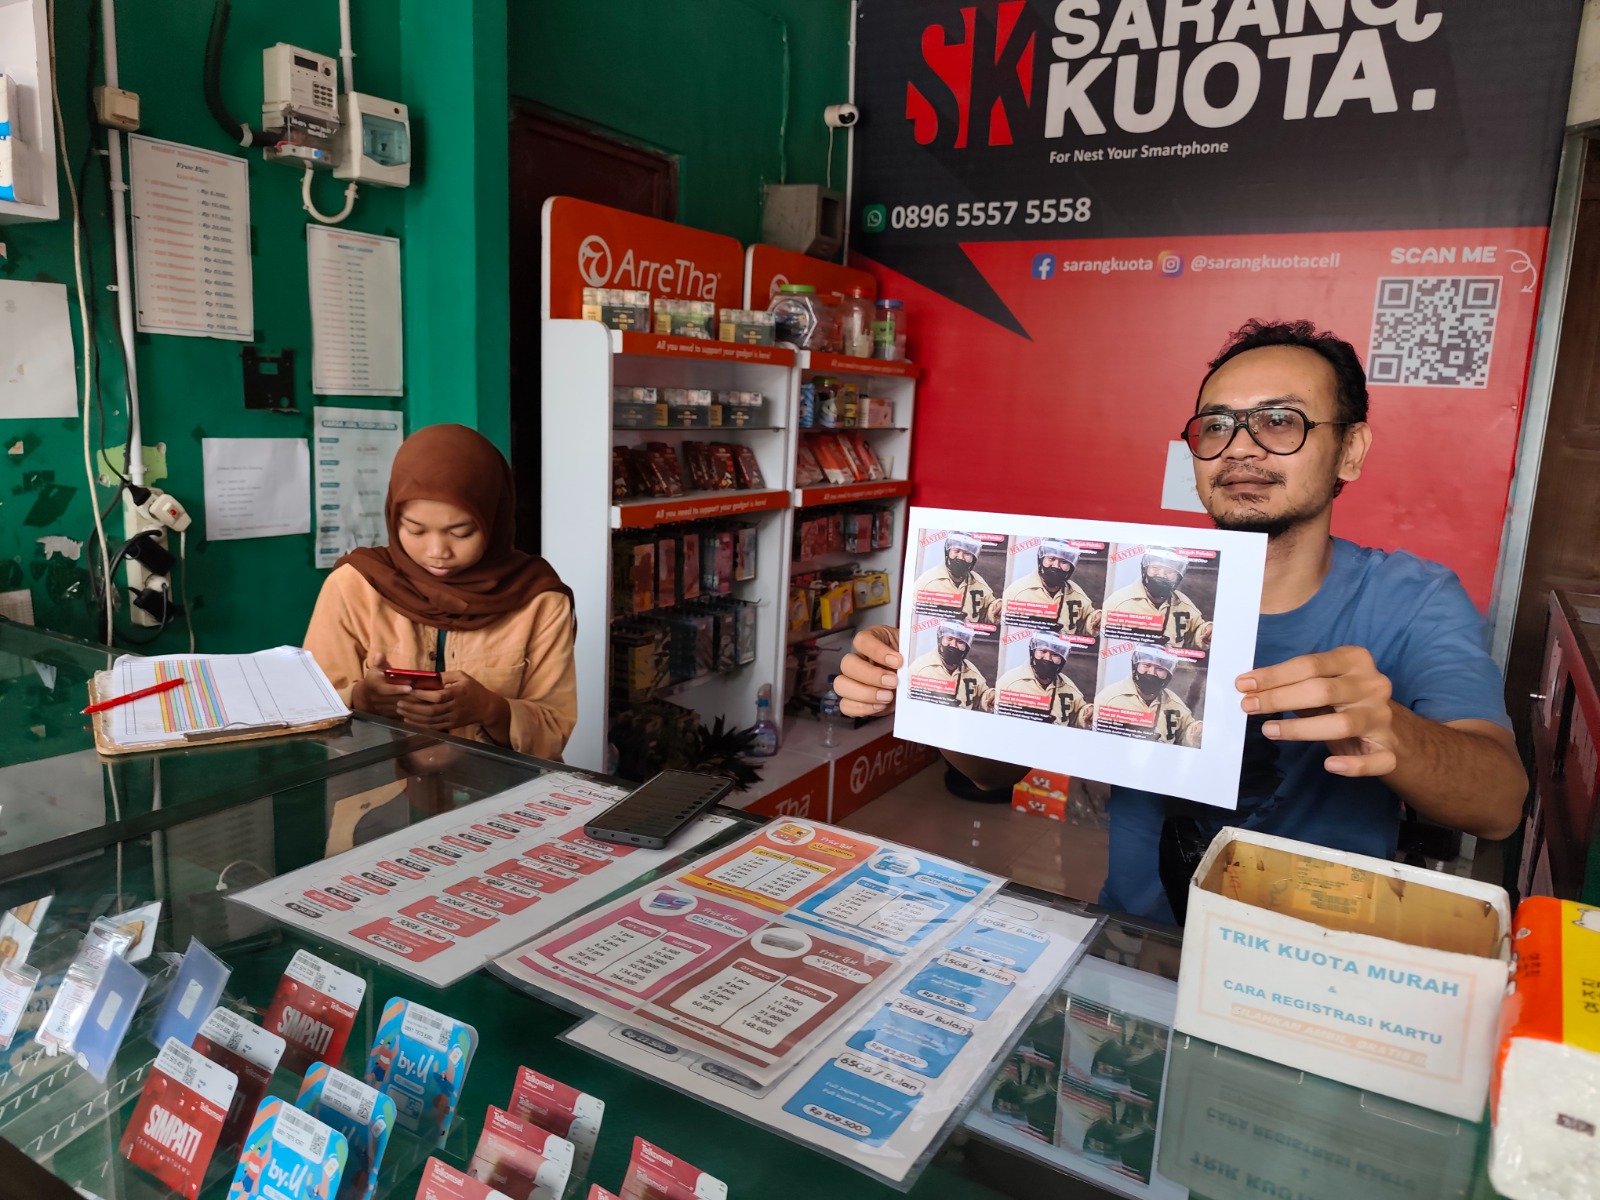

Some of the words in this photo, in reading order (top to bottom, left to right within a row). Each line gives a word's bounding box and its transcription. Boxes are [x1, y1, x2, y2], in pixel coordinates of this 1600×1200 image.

[1044, 29, 1436, 138] KUOTA.
[1049, 151, 1071, 164] For
[1074, 148, 1103, 163] Nest
[1107, 145, 1138, 160] Your
[1141, 140, 1229, 158] Smartphone
[891, 204, 949, 228] 0896
[955, 201, 1016, 227] 5557
[1025, 197, 1092, 225] 5558
[1063, 256, 1153, 274] sarangkuota
[1191, 252, 1340, 272] @sarangkuotacell
[1390, 246, 1455, 265] SCAN
[1461, 246, 1497, 264] ME
[613, 249, 718, 300] ArreTha
[1010, 538, 1039, 554] WANTED
[1111, 545, 1144, 562] WANTED
[970, 590, 984, 618] F
[1066, 600, 1082, 630] F
[1002, 630, 1031, 645] WANTED
[1173, 611, 1190, 643] F
[1102, 643, 1134, 658] WANTED
[963, 678, 976, 706] F
[1058, 693, 1073, 722] F
[1164, 710, 1181, 740] F
[469, 906, 492, 919] Bulan
[423, 928, 447, 942] Bulan
[982, 916, 1006, 928] 10GB
[1015, 927, 1043, 940] Bulan
[943, 956, 969, 969] 15GB
[978, 968, 1008, 982] Bulan
[1220, 927, 1270, 952] TRIK
[1278, 943, 1359, 975] KUOTA
[1368, 964, 1459, 997] MURAH
[720, 988, 737, 996] pcs
[728, 983, 744, 991] pcs
[735, 978, 751, 986] pcs
[792, 985, 818, 997] HARGA
[1327, 985, 1337, 994] &
[707, 998, 723, 1006] pcs
[714, 993, 731, 1001] pcs
[921, 990, 934, 998] Rp
[330, 1001, 354, 1018] Telkomsel
[699, 1004, 715, 1013] pcs
[895, 1001, 925, 1016] 35GB
[934, 1015, 968, 1032] Bulan
[1223, 979, 1266, 999] CARA
[1272, 992, 1374, 1028] REGISTRASI
[1380, 1020, 1443, 1045] KARTU
[1232, 1005, 1301, 1033] SILAHKAN
[277, 1006, 334, 1055] SIMPATI
[869, 1042, 883, 1050] Rp
[397, 1051, 435, 1083] by.U
[839, 1056, 872, 1074] 65GB
[882, 1072, 919, 1092] Bulan
[525, 1071, 555, 1091] Telkomsel
[200, 1102, 224, 1122] Telkomsel
[809, 1106, 823, 1115] Rp
[494, 1112, 523, 1132] Telkomsel
[144, 1104, 202, 1163] SIMPATI
[641, 1144, 674, 1167] Telkomsel
[267, 1158, 309, 1198] by.U
[433, 1163, 464, 1187] Telkomsel
